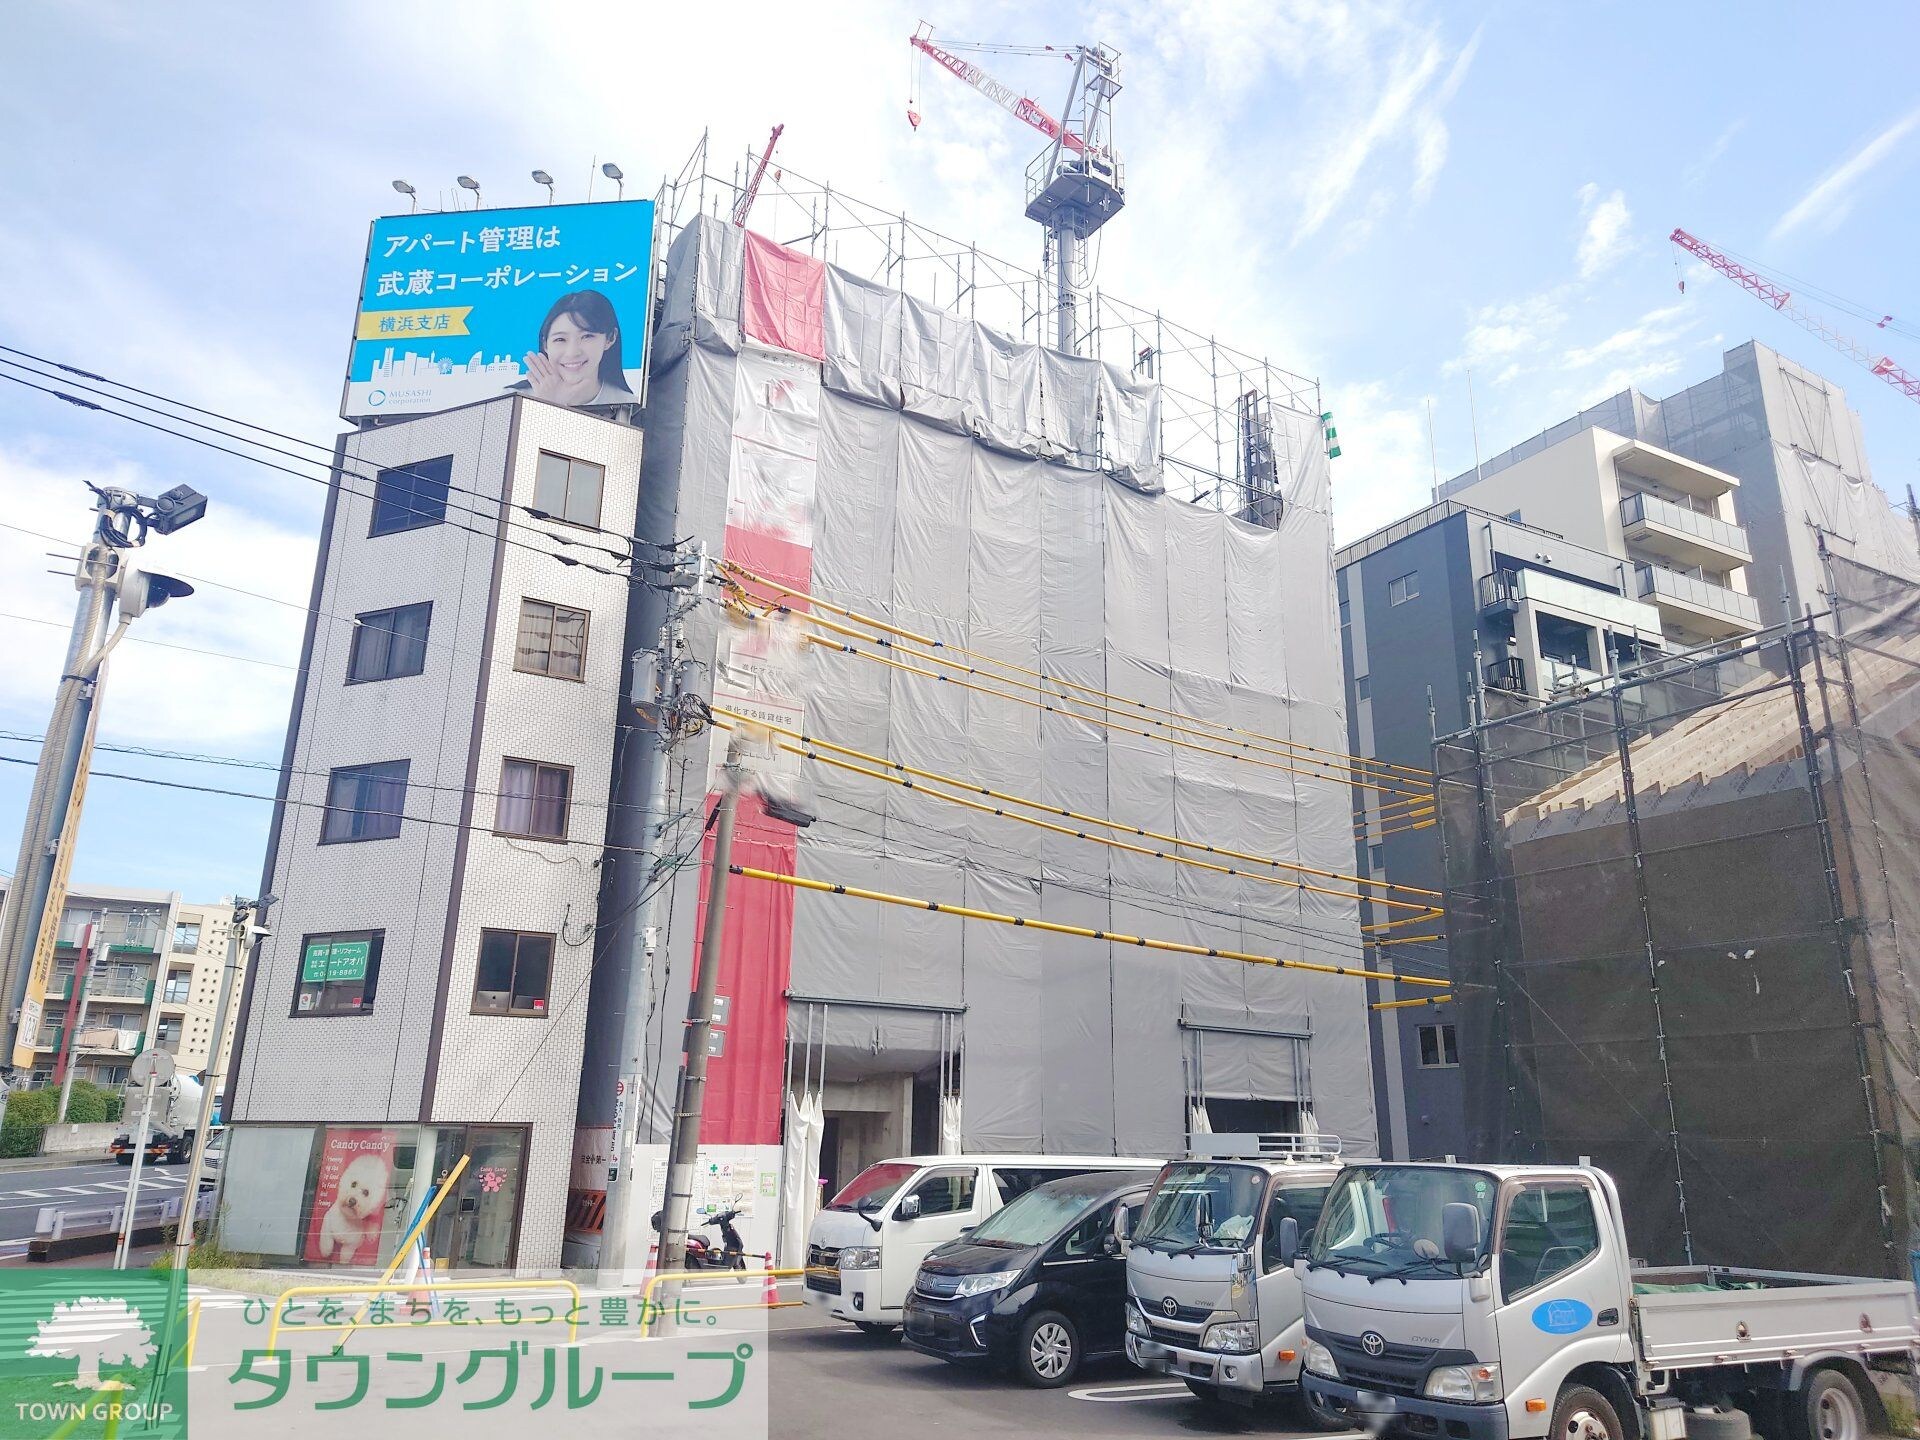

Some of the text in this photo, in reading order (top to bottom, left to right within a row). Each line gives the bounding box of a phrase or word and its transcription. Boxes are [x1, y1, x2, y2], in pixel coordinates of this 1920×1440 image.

[384, 226, 561, 257] アパート管理は
[376, 262, 638, 297] 武蔵コーポレーション
[379, 314, 451, 332] 横浜支店
[389, 389, 432, 398] MUSASHI
[725, 704, 792, 724] 進化する賃貸住宅
[330, 1139, 390, 1153] Candy Candy
[1411, 1335, 1441, 1345] DYNA
